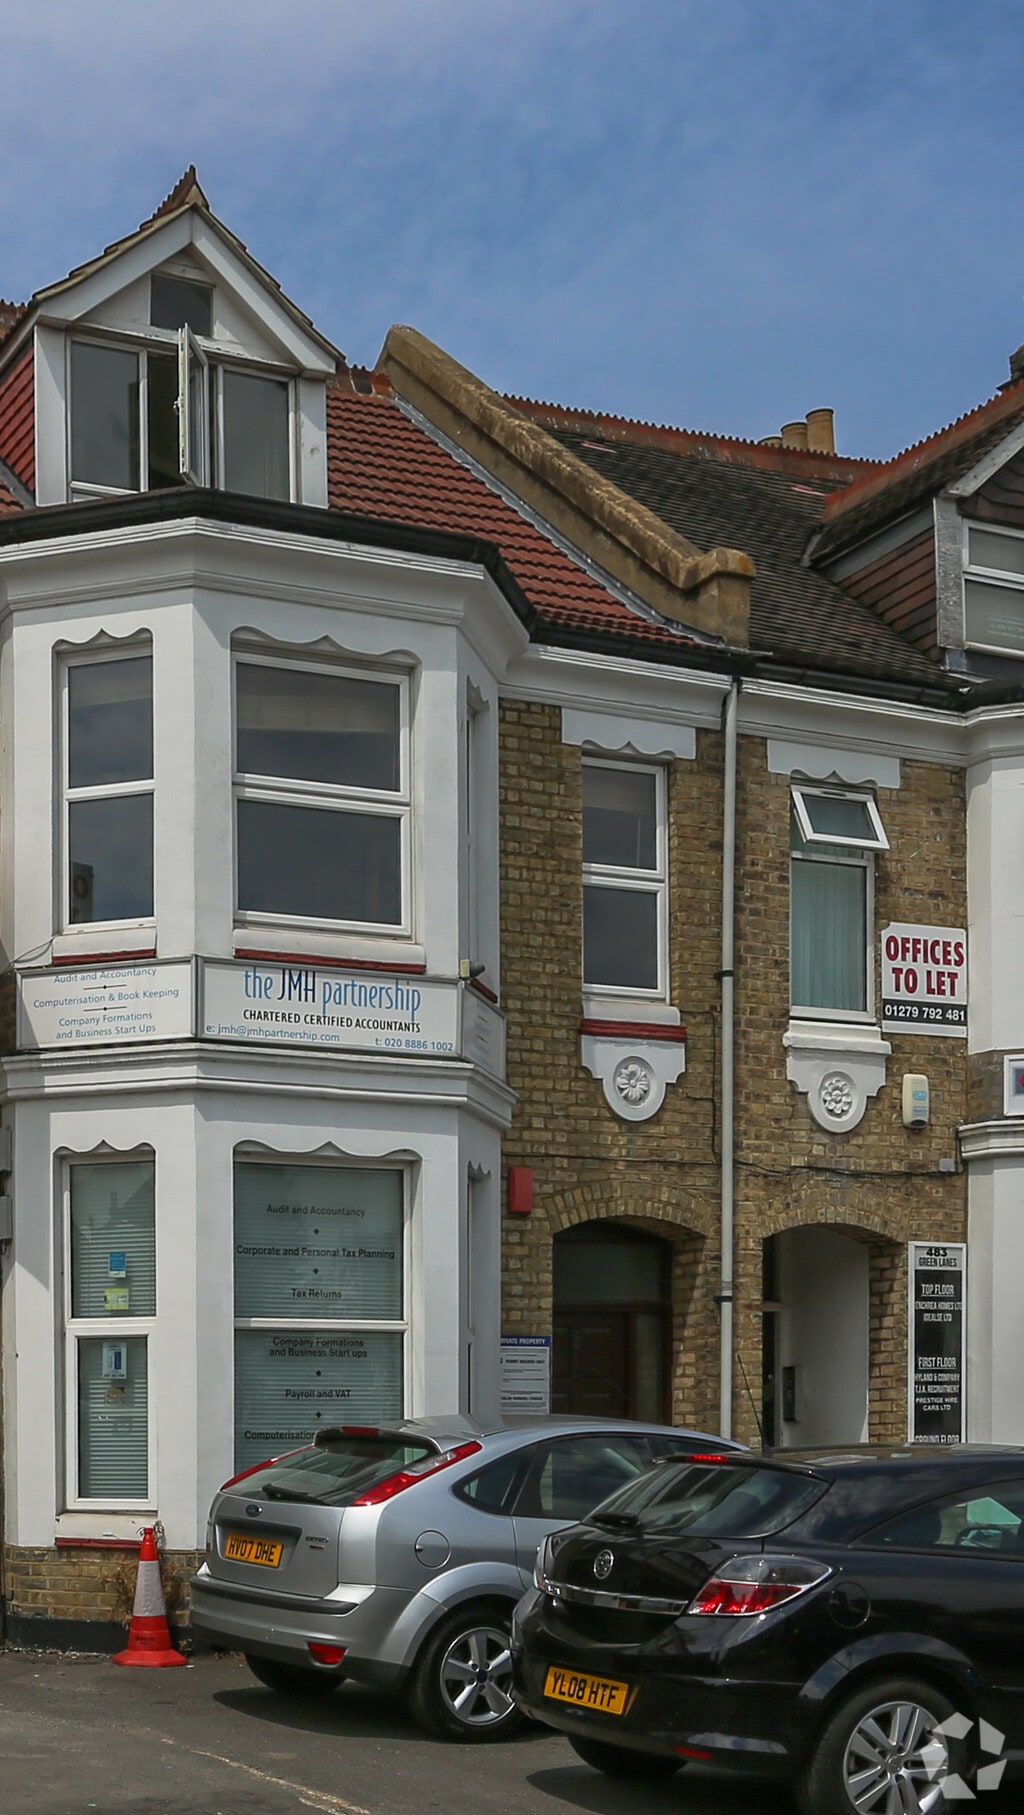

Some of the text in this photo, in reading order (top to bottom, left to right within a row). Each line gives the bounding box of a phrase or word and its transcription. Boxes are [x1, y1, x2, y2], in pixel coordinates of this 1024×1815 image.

[885, 935, 965, 967] OFFICES
[54, 968, 157, 983] Audit and Accountancy
[892, 967, 958, 997] TO LET
[33, 988, 179, 1008] Computerisation & Book Keeping
[244, 966, 421, 1021] the JMH partnership
[59, 1012, 152, 1027] Company Formations
[885, 1004, 965, 1021] 01279 792 481
[243, 1009, 421, 1033] CHARTERED CERTIFIED ACCOUNTANTS
[56, 1024, 156, 1039] and Business Start Ups
[206, 1024, 340, 1043] e: jmh@jmhpartnership.com
[375, 1037, 454, 1051] t: 020 8886 1002
[267, 1204, 366, 1219] Audit and Accountancy
[236, 1245, 395, 1260] Corporate and Personal Tax Planning
[926, 1248, 948, 1257] 483
[919, 1257, 957, 1267] GREEN LANES
[291, 1288, 342, 1299] Tax Returns
[921, 1284, 954, 1295] TOP FLOOR
[272, 1337, 364, 1348] Company Formations
[269, 1348, 286, 1356] and
[288, 1348, 327, 1357] Business
[328, 1349, 350, 1357] Start
[918, 1357, 956, 1367] FIRST FLOOR
[285, 1389, 351, 1400] Payroll and VAT
[927, 1385, 959, 1393] RECRUITMENT
[228, 1536, 277, 1562] HV07 DHE
[551, 1672, 620, 1707] YL08 HTF
